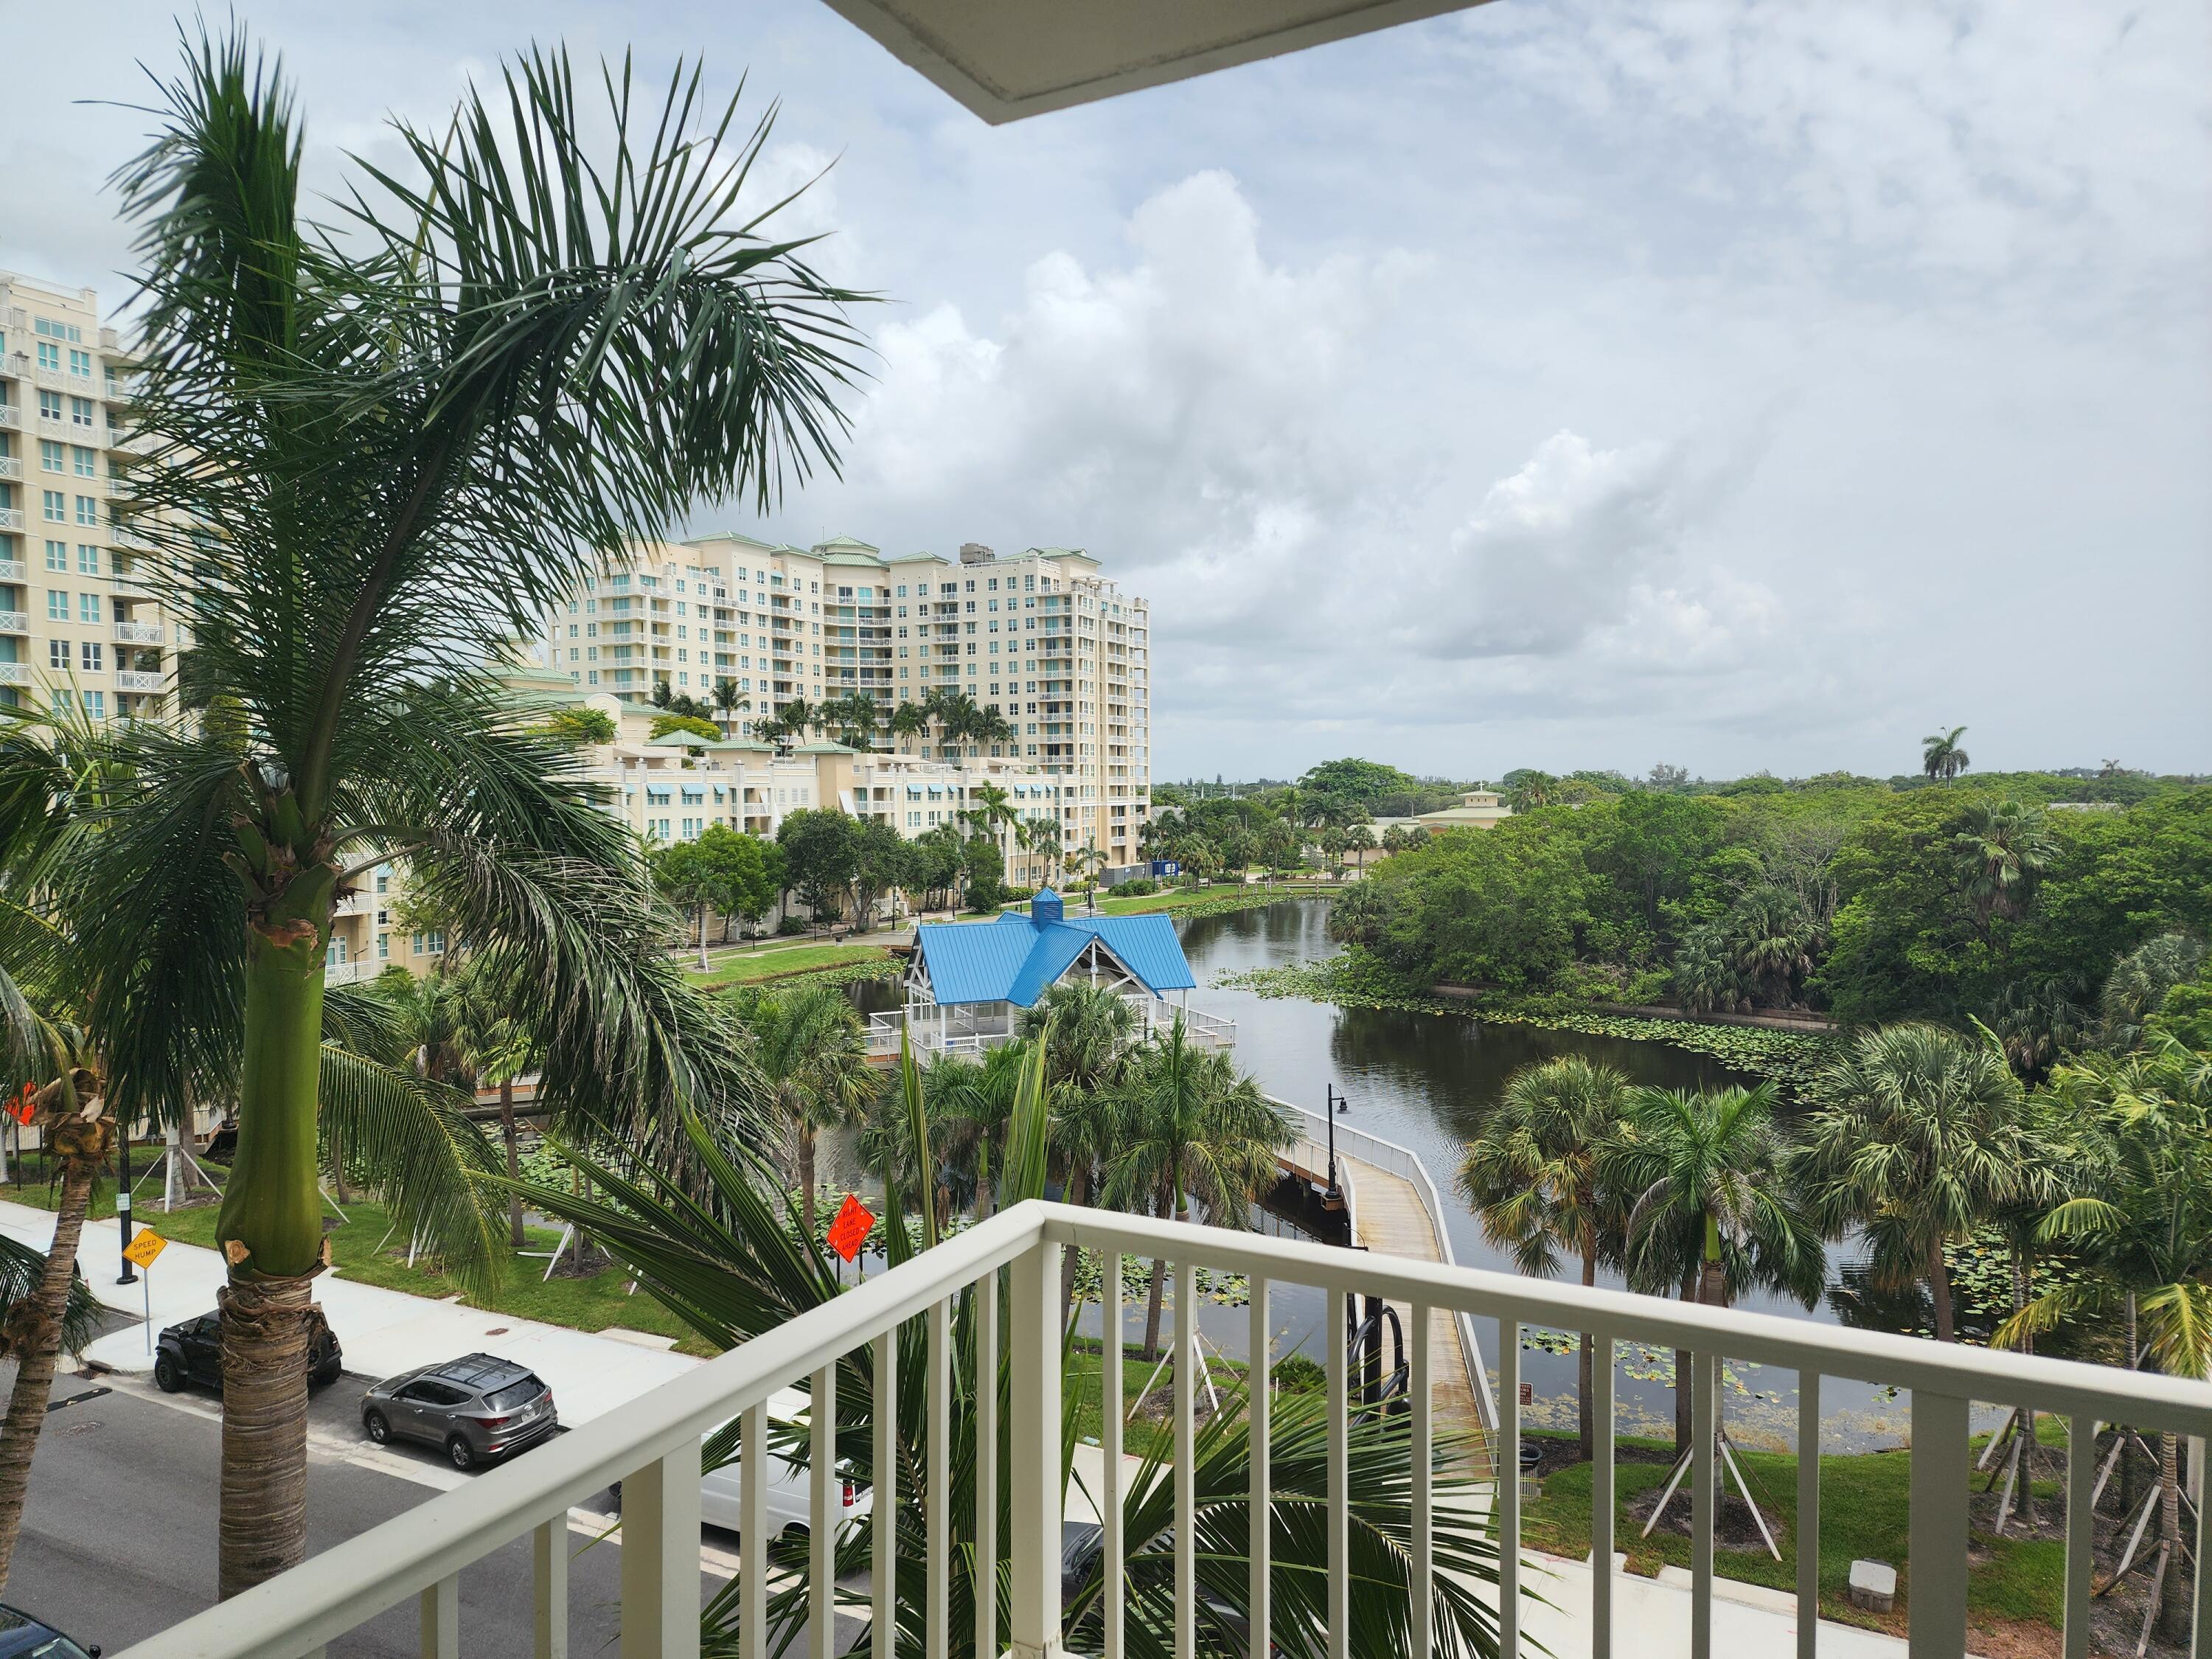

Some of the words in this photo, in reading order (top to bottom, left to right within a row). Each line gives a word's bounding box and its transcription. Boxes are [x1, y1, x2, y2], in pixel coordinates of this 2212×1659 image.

[843, 1207, 857, 1218] RIGHT
[844, 1218, 856, 1229] LANE
[840, 1227, 860, 1241] CLOSED
[133, 1239, 156, 1251] SPEED
[842, 1239, 858, 1251] AHEAD
[135, 1249, 156, 1259] HUMP
